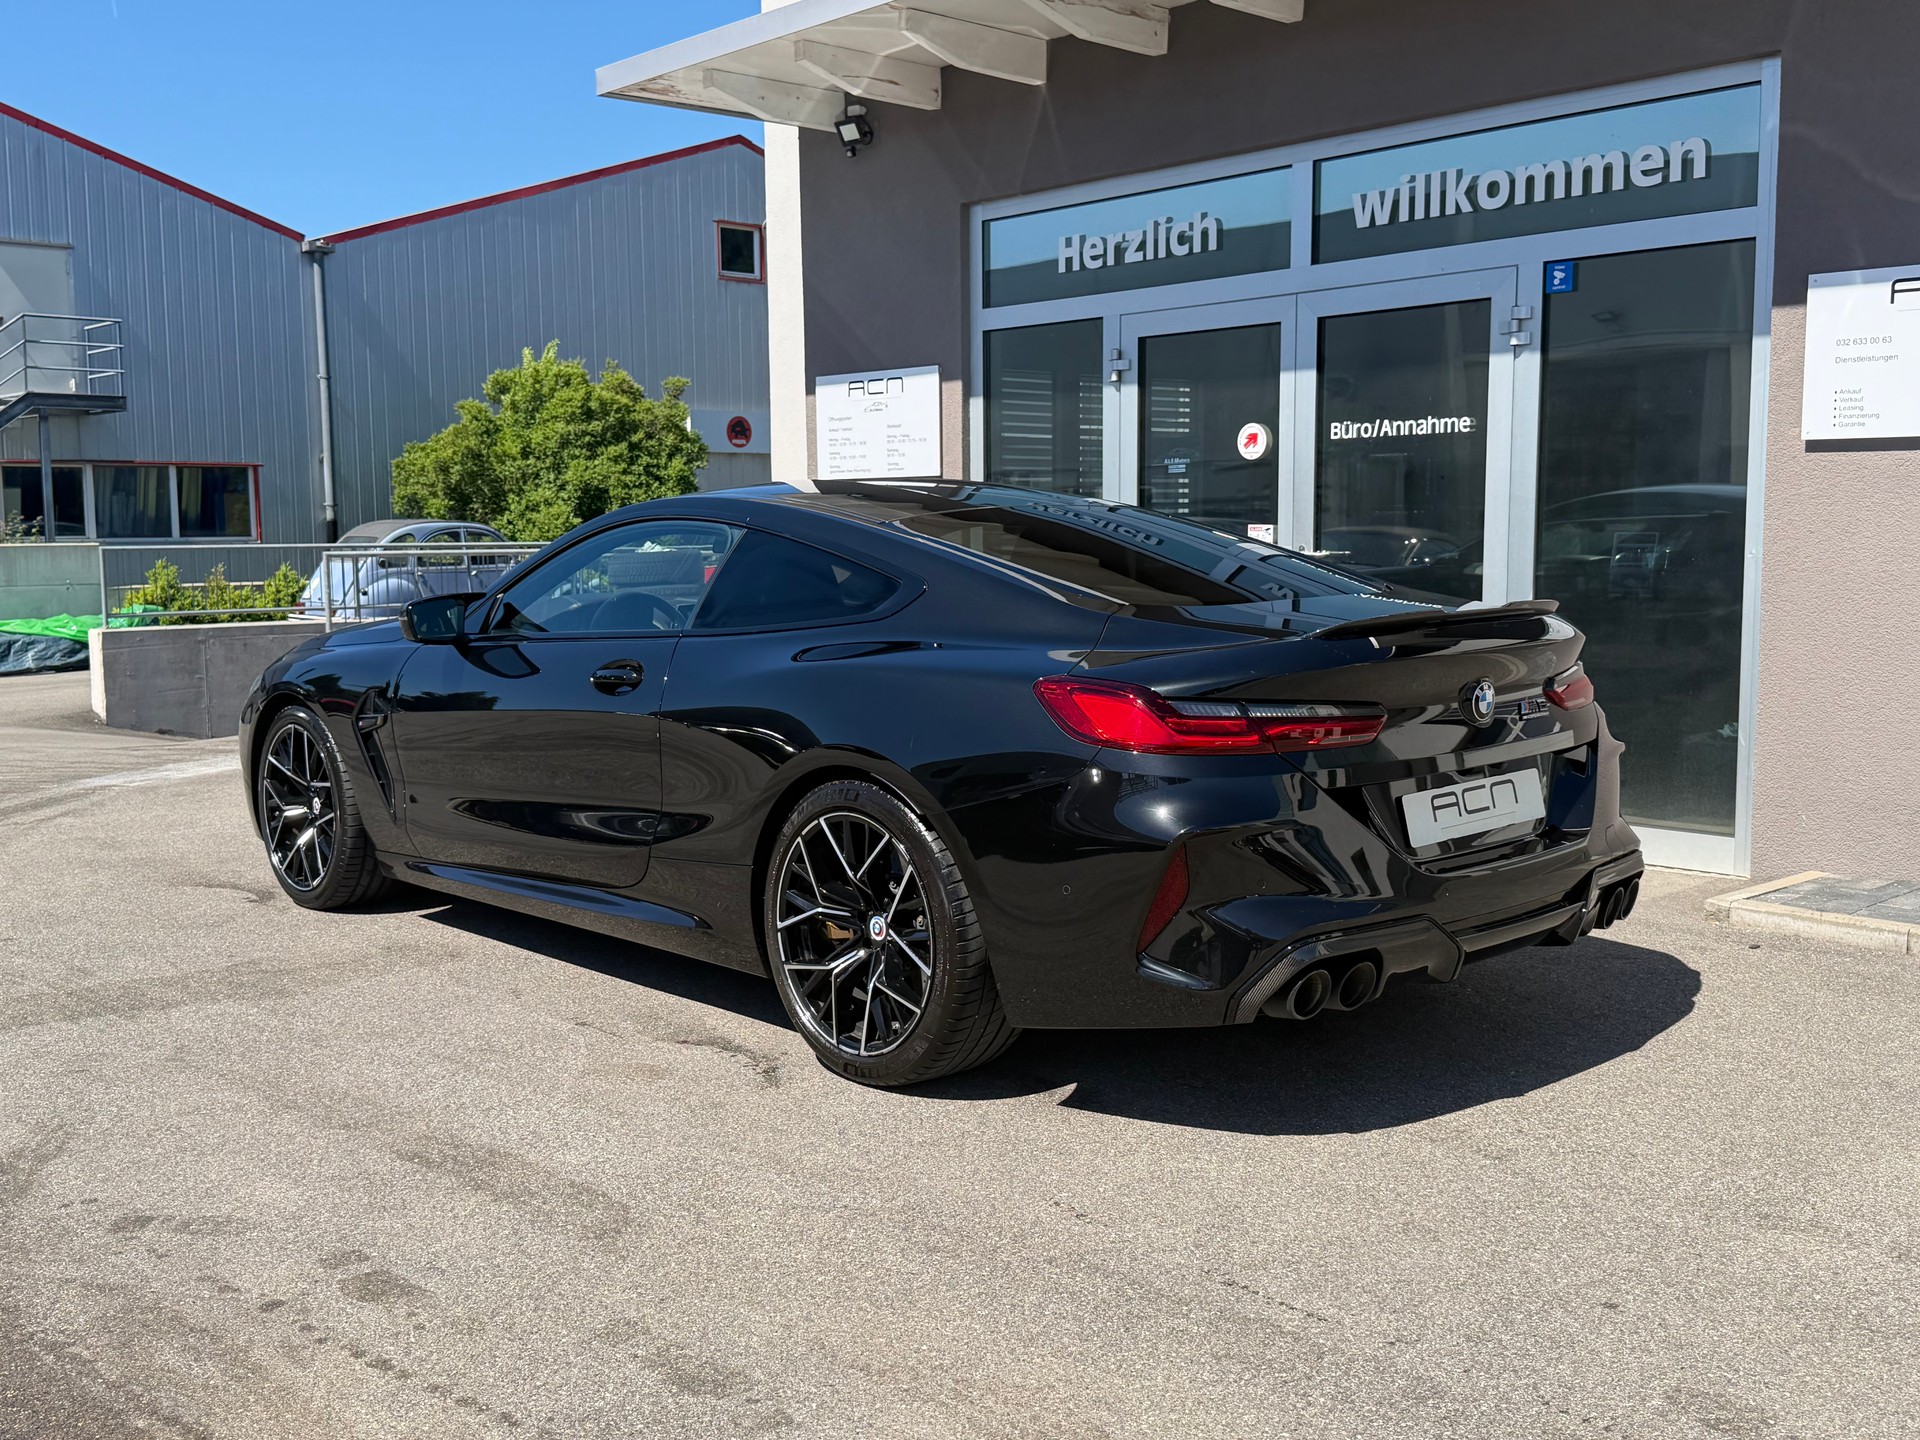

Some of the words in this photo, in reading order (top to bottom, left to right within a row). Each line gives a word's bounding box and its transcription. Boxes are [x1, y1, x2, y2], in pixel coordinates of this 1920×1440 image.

[1352, 137, 1707, 229] willkommen
[1058, 211, 1218, 274] Herzlich
[1853, 337, 1868, 345] 633
[1869, 336, 1880, 344] 00
[1882, 335, 1893, 344] 63
[1835, 354, 1899, 364] Dienstleistungen
[1330, 416, 1471, 440] Büro/Annahme
